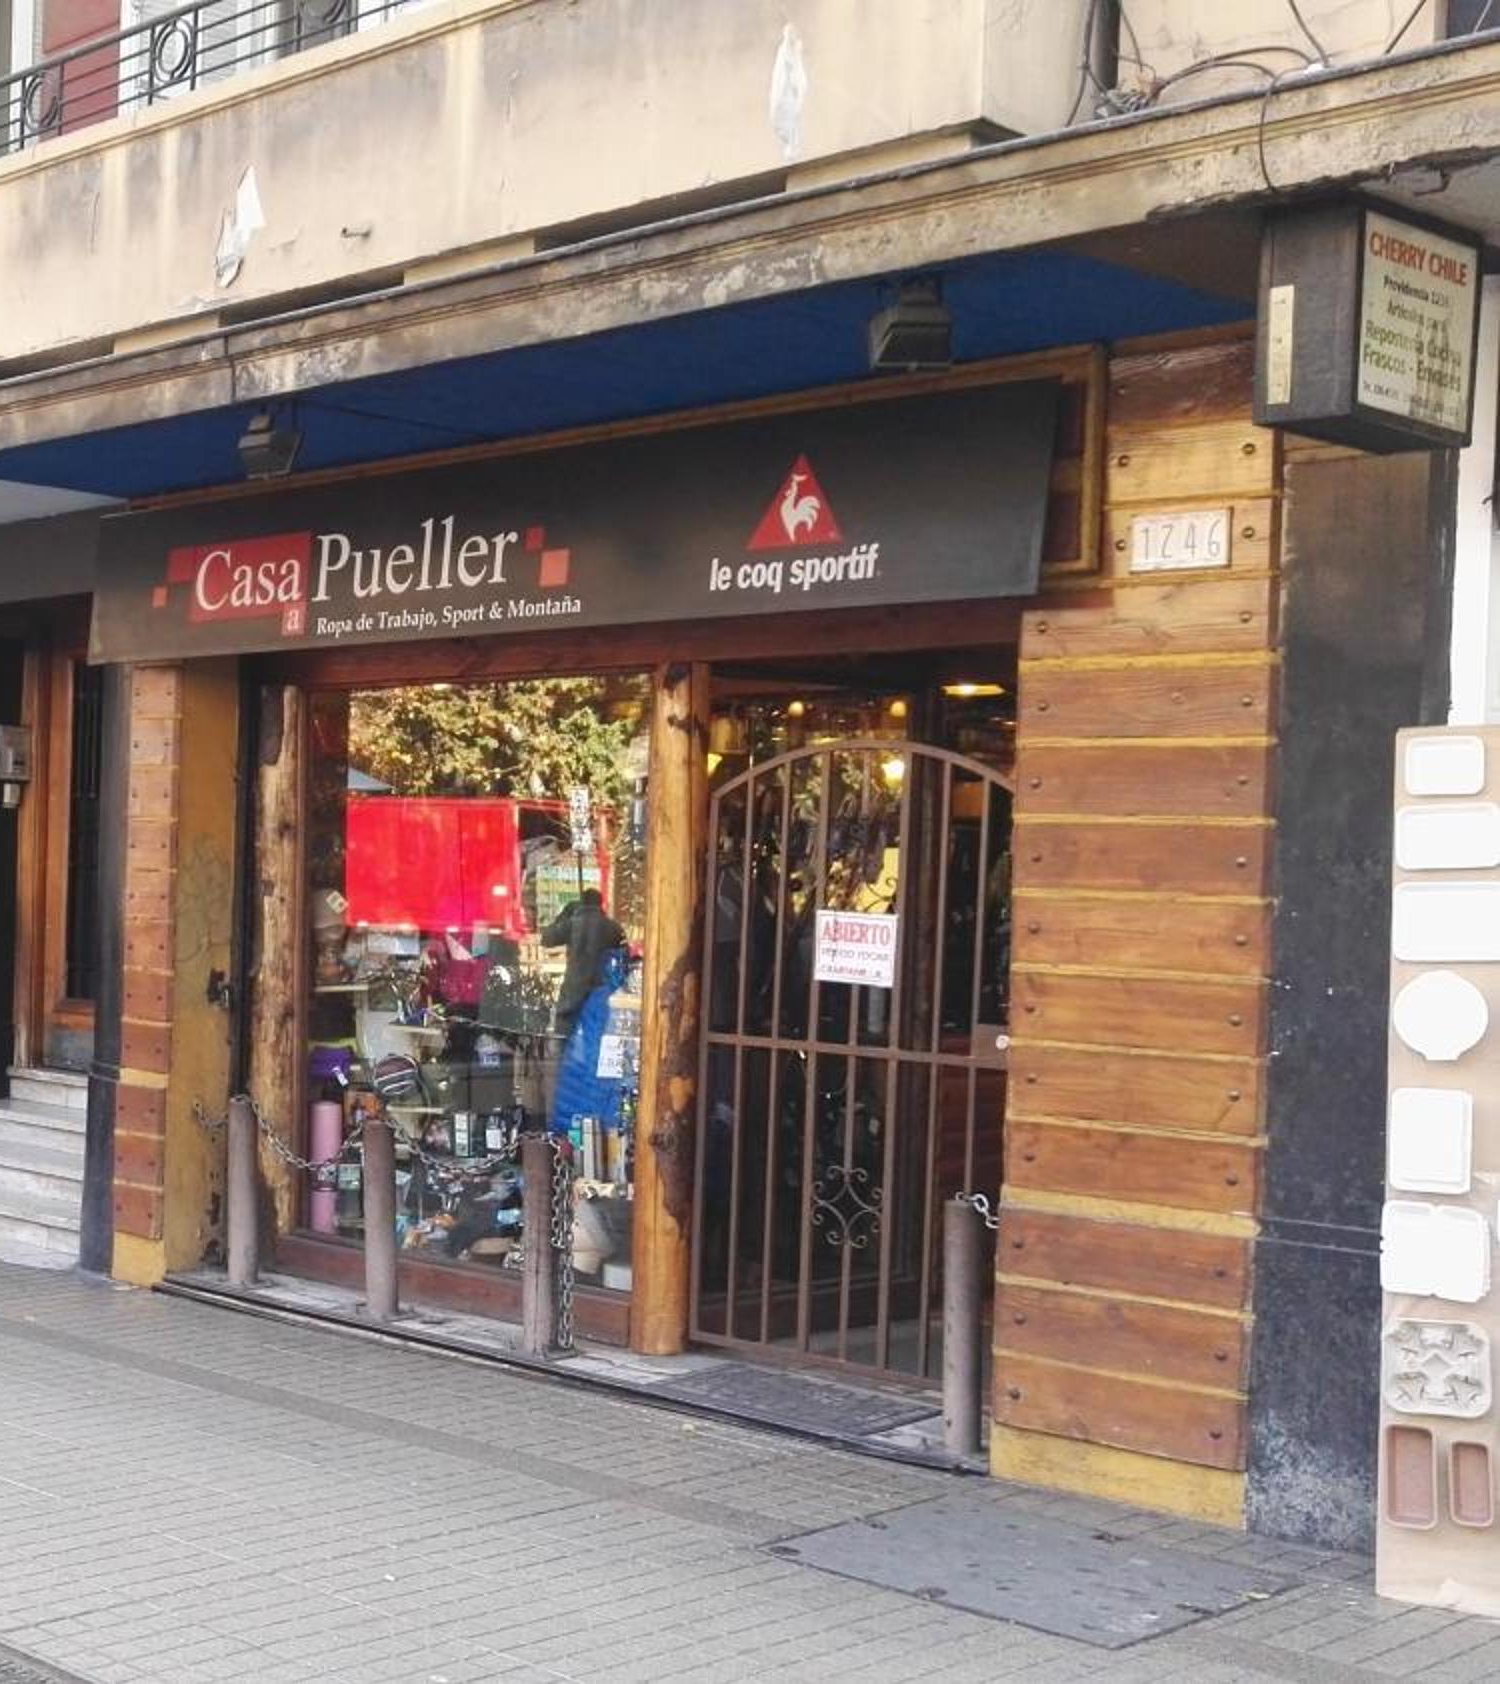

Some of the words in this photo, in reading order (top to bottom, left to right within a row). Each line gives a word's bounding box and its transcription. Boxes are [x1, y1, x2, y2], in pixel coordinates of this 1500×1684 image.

[1370, 231, 1427, 272] CHERRY
[1429, 253, 1467, 287] CHILE
[1140, 519, 1221, 561] 1246
[195, 550, 302, 612] Casa
[311, 515, 518, 602] Pueller
[710, 558, 732, 590] le
[737, 561, 783, 592] coq
[790, 543, 879, 590] sportif
[316, 616, 351, 638] Ropa
[356, 613, 373, 631] de
[377, 608, 437, 631] Trabajo,
[442, 605, 484, 629] Sport
[489, 602, 503, 619] &
[507, 596, 581, 618] Montaña
[820, 920, 891, 946] ABIERTO
